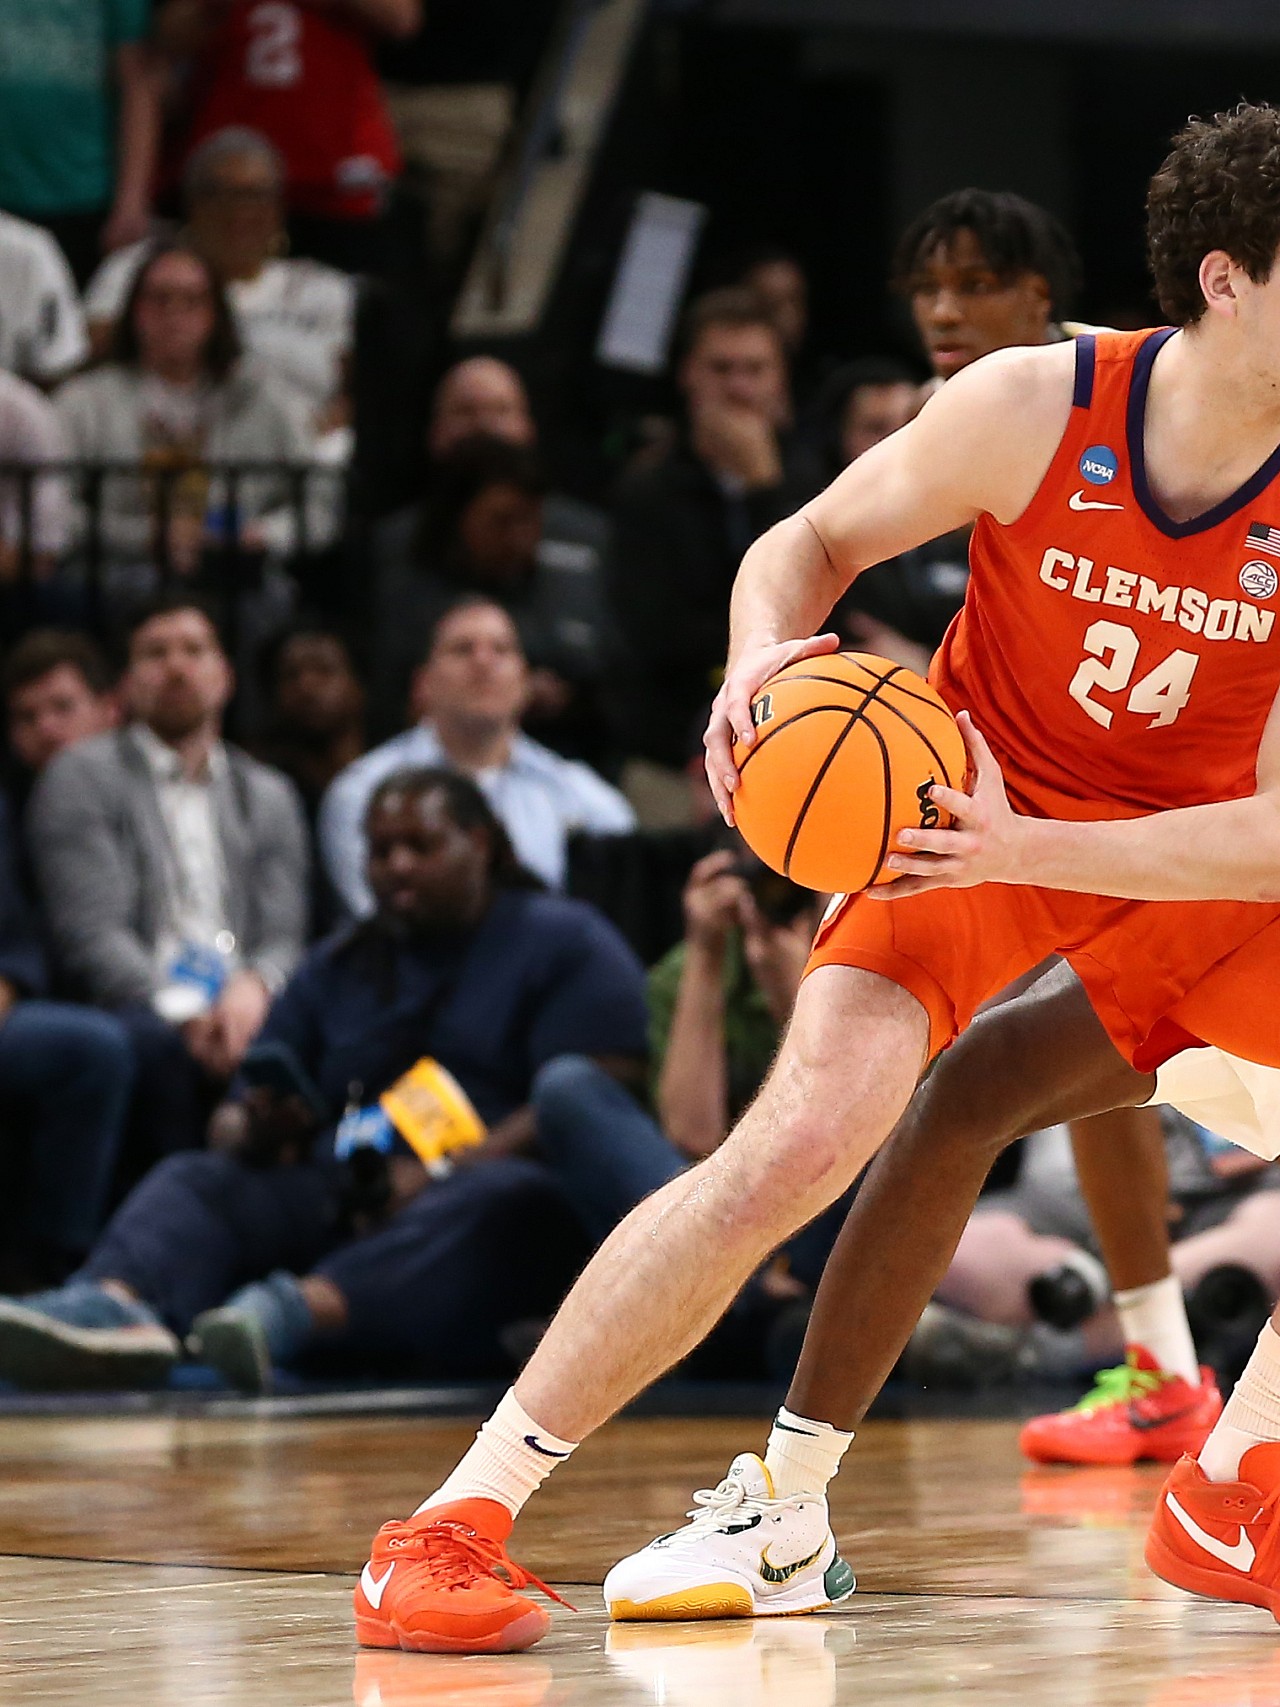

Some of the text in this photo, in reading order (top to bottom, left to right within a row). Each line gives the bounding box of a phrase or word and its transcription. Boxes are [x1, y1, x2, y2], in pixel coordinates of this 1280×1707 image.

[248, 3, 301, 84] 2
[1082, 459, 1114, 481] NCAA
[1038, 547, 1276, 643] CLEMSON
[1068, 619, 1200, 731] 24
